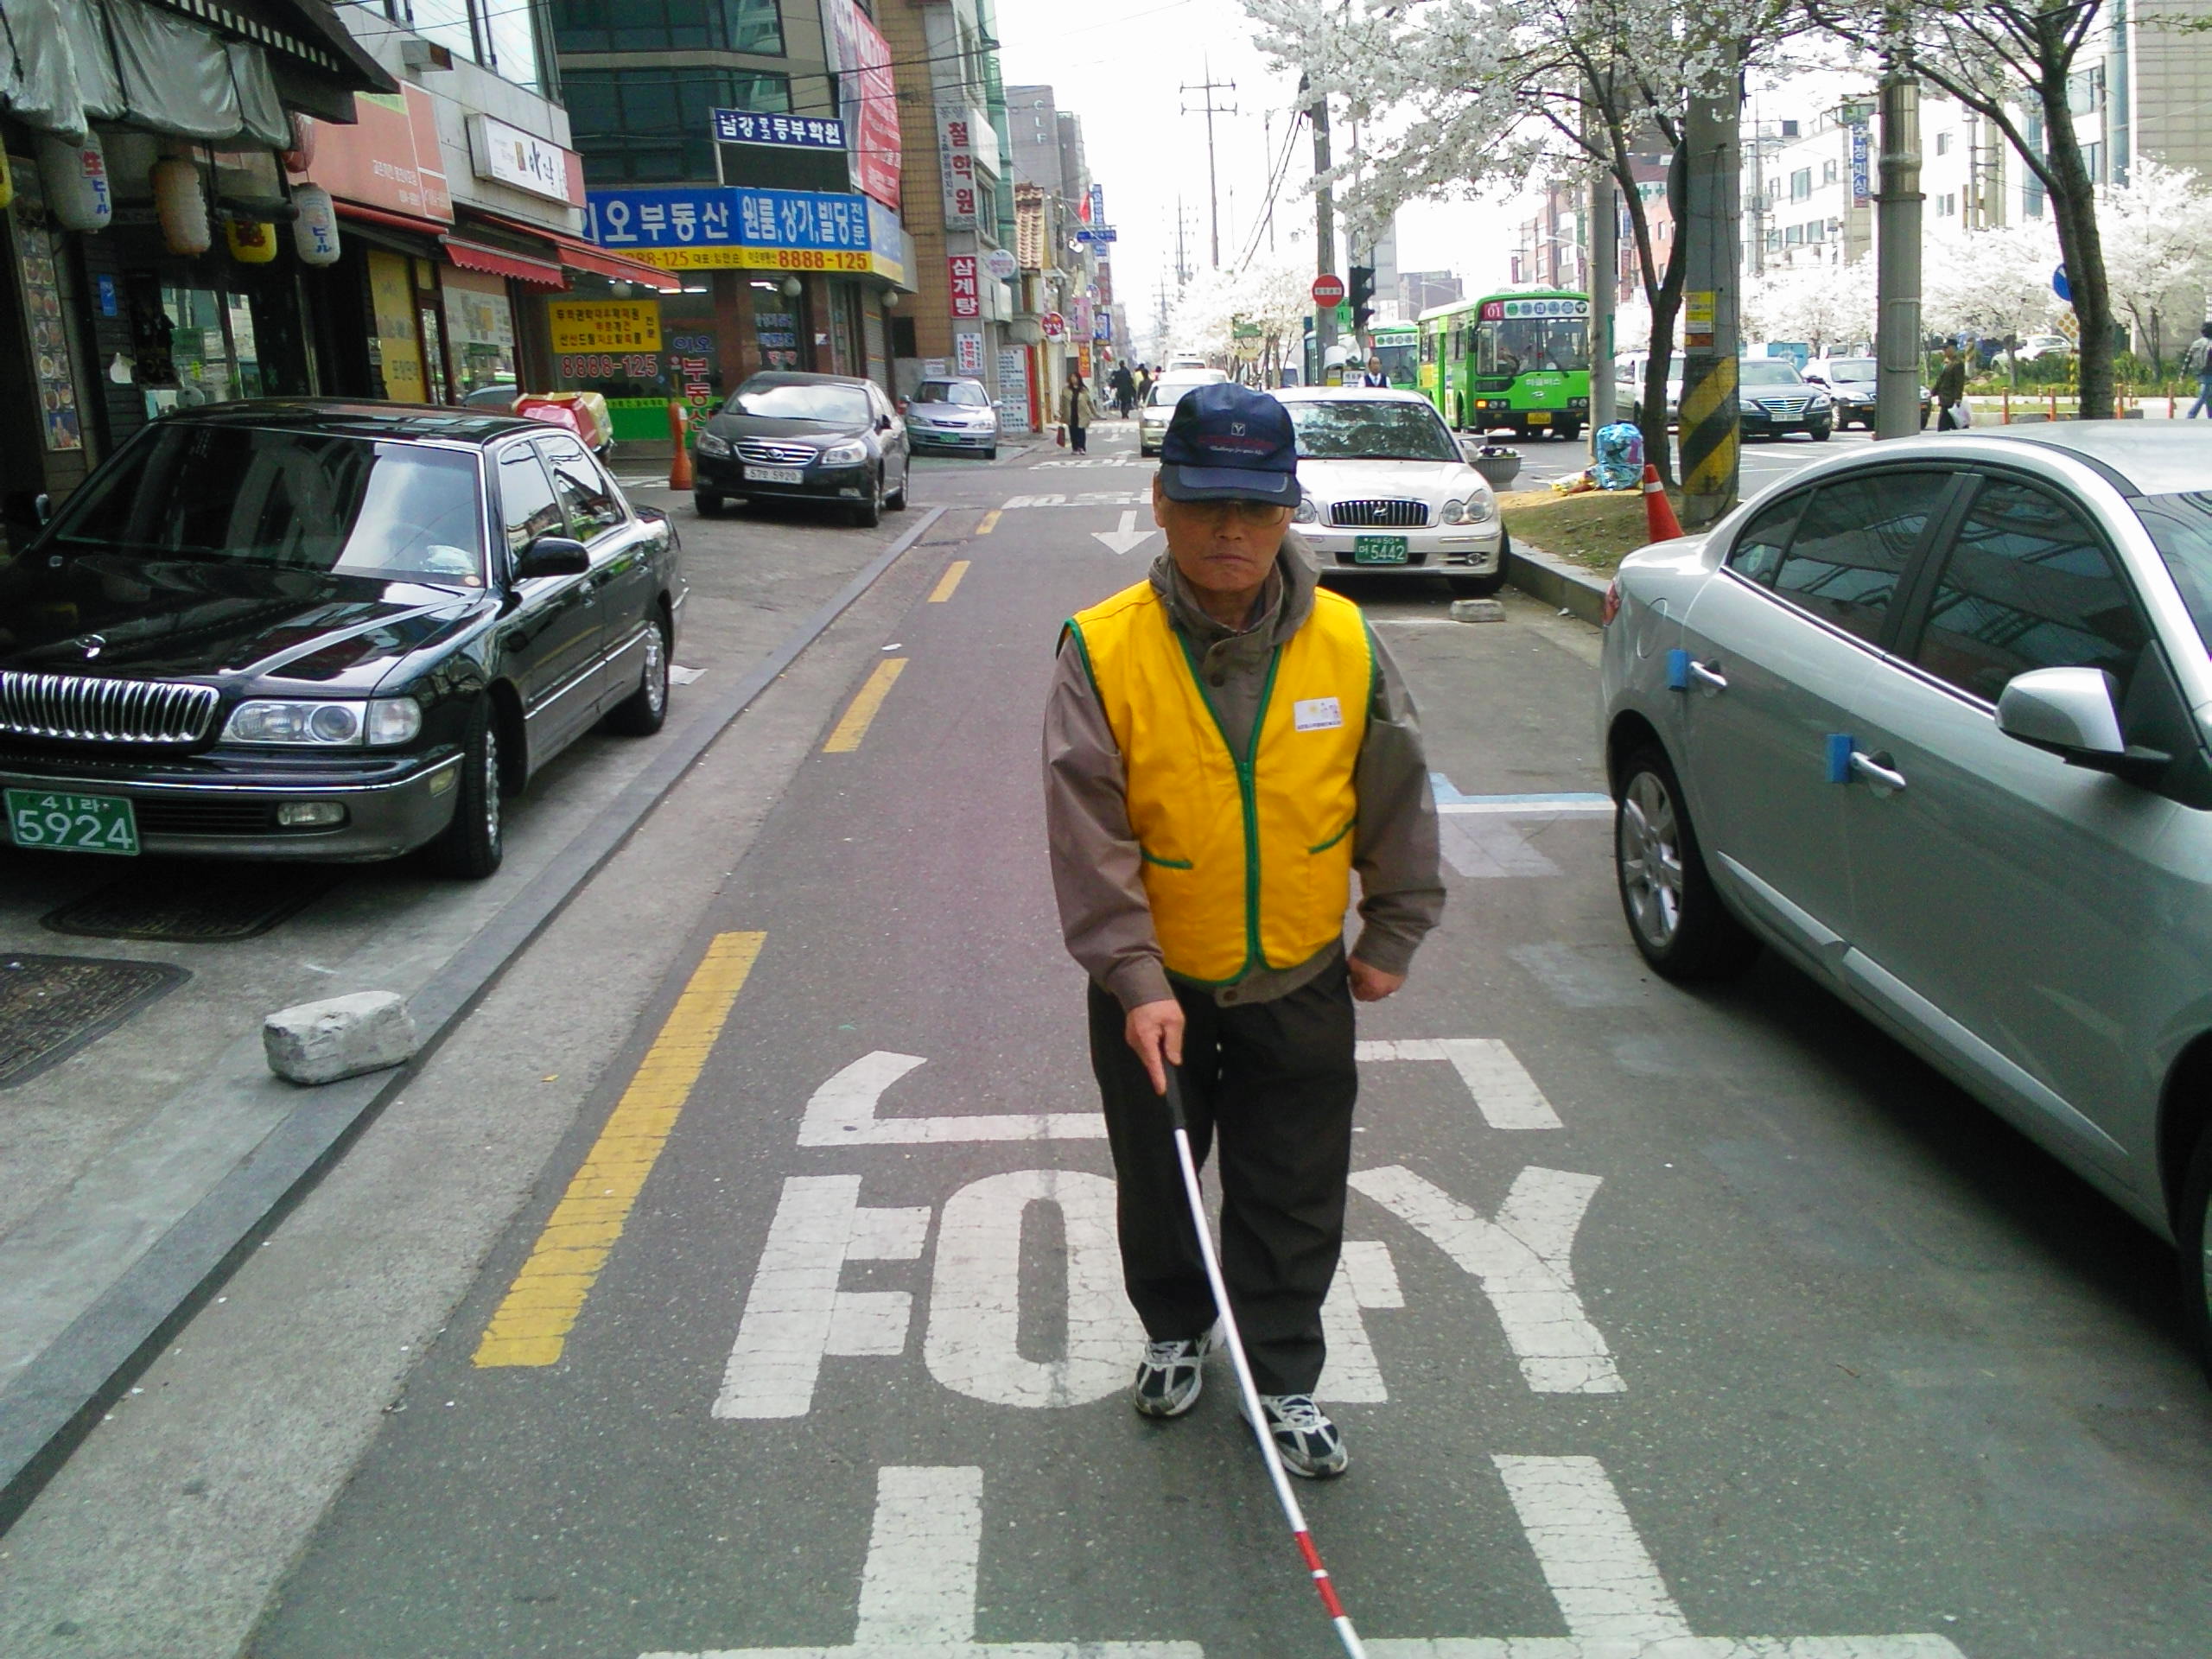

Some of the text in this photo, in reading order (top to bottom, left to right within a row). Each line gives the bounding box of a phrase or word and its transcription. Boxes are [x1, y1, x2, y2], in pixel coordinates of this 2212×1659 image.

[949, 121, 976, 214] 철학원
[779, 250, 868, 270] 8888-125
[952, 259, 978, 315] 삼계탕
[1487, 307, 1501, 317] 01
[673, 335, 715, 353] 이오
[563, 354, 658, 378] 8888-125
[1370, 544, 1405, 560] 5442
[17, 810, 133, 849] 5924
